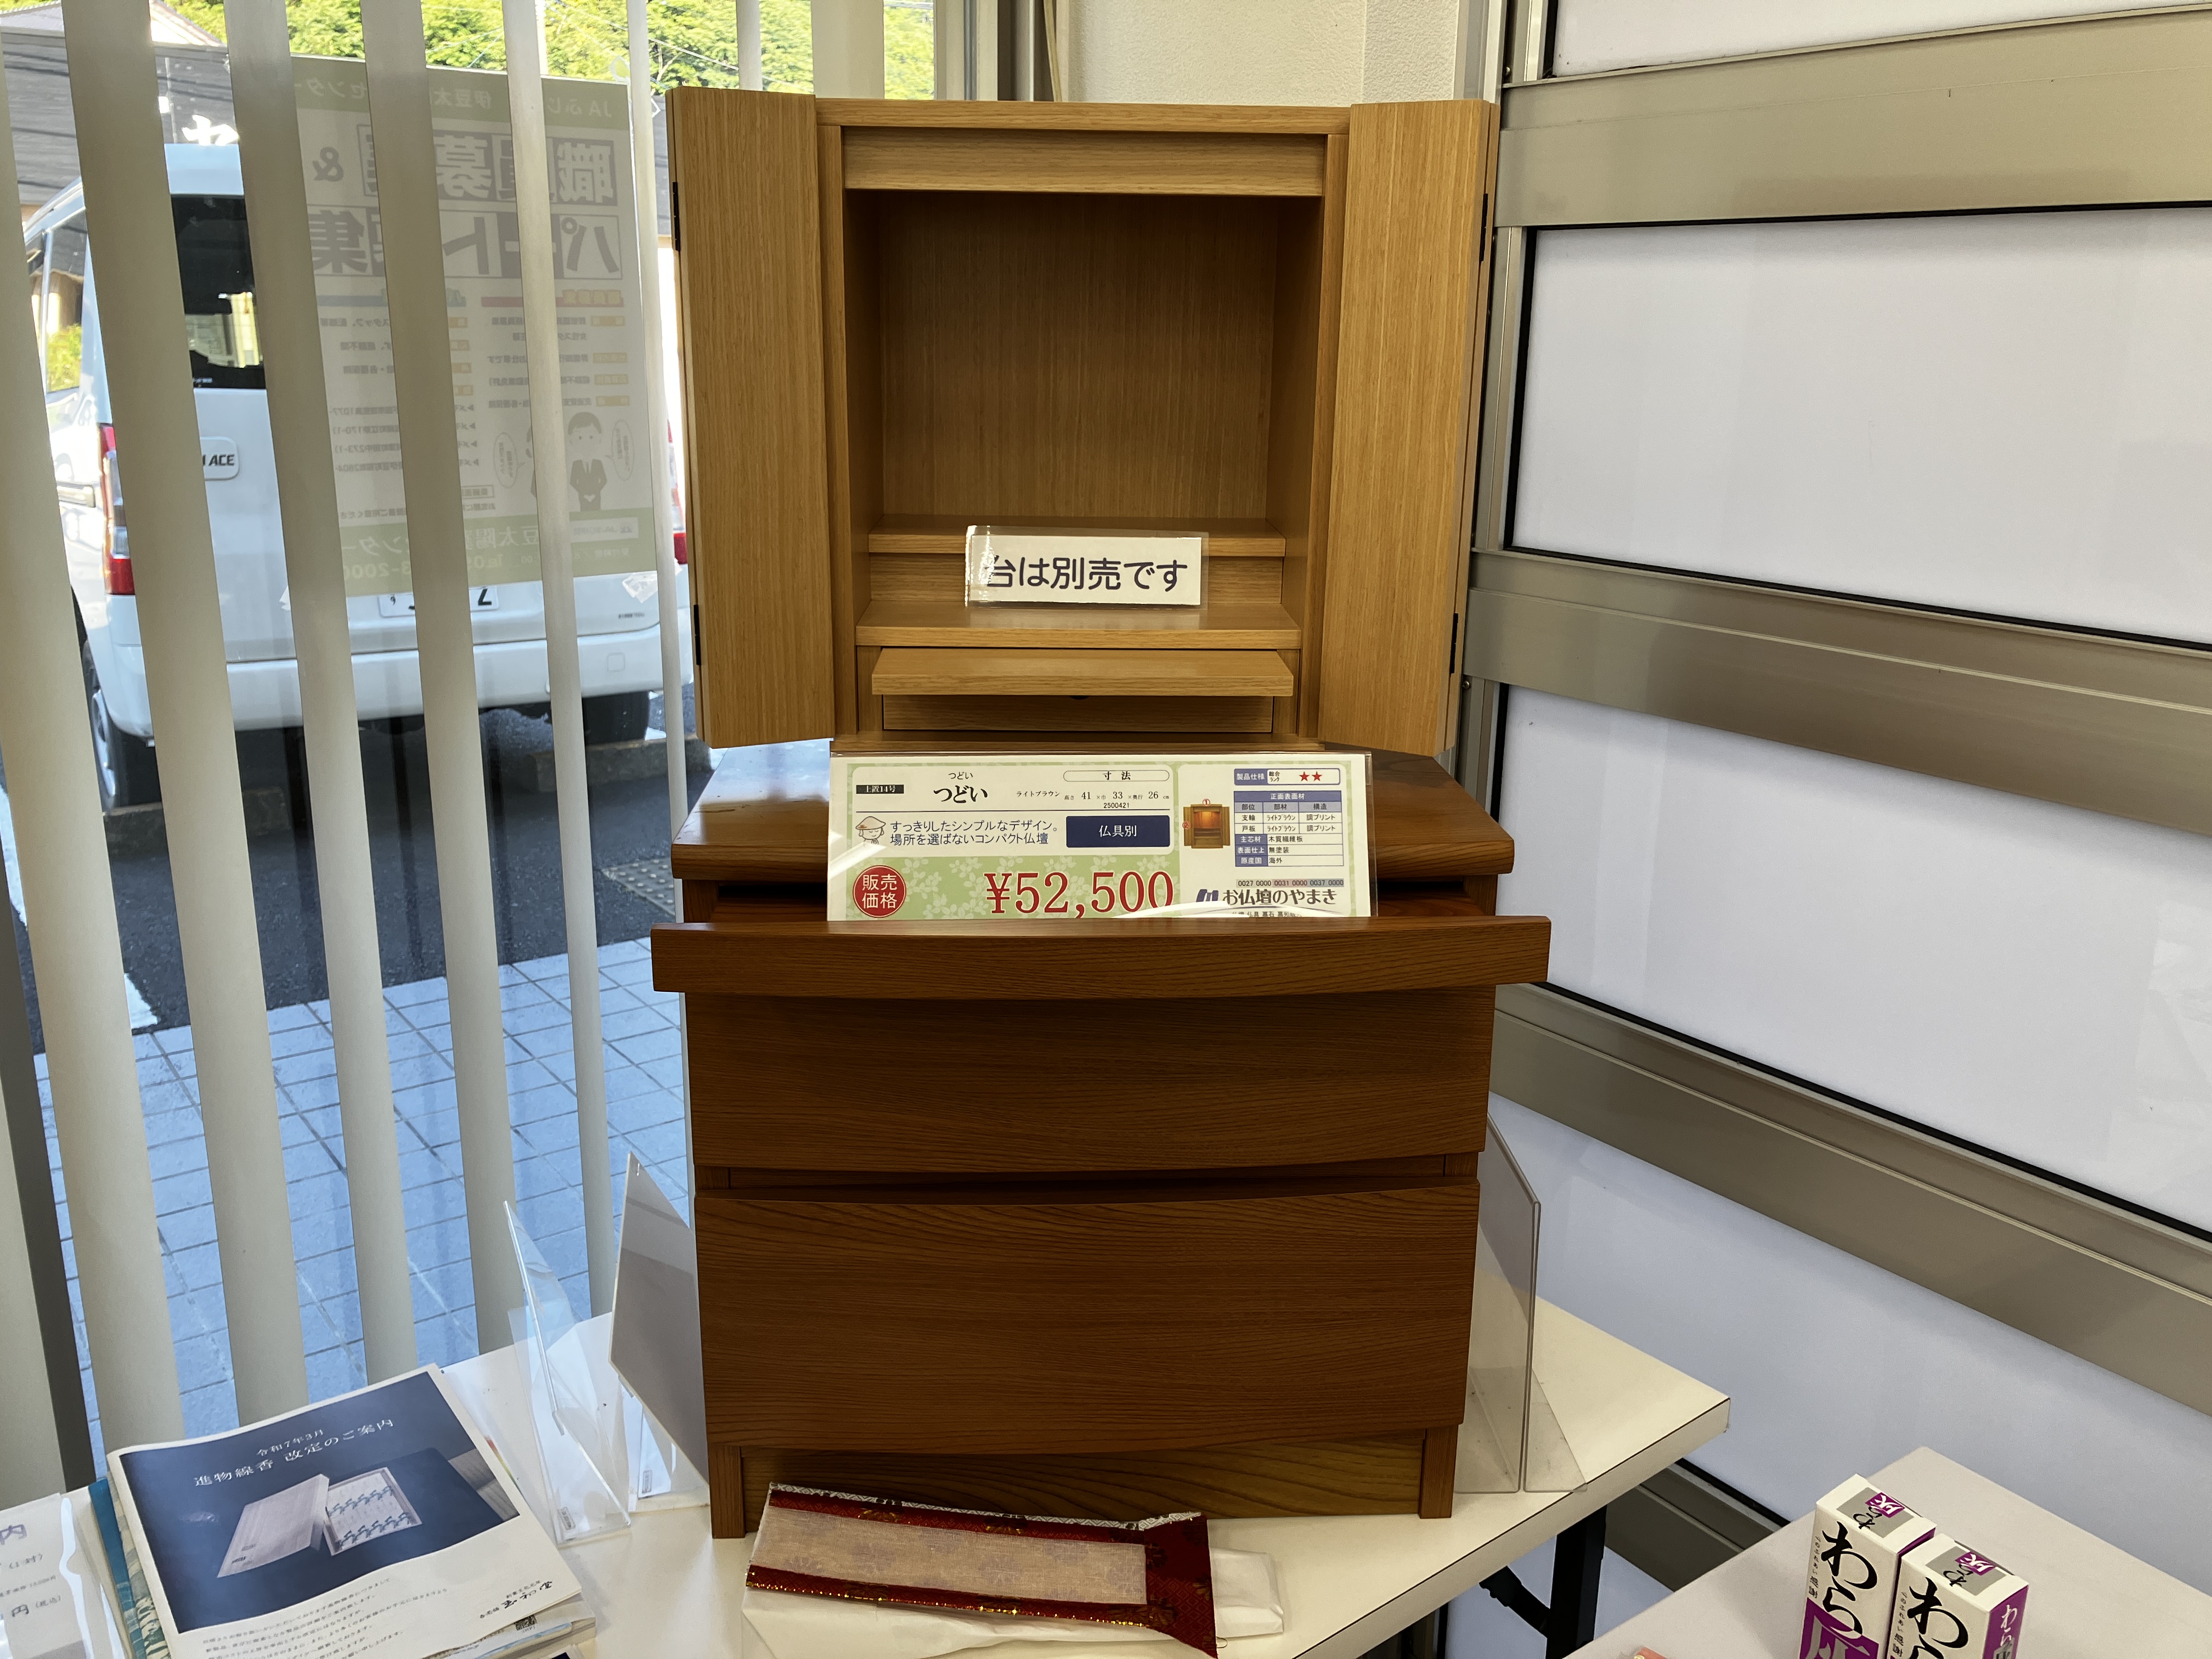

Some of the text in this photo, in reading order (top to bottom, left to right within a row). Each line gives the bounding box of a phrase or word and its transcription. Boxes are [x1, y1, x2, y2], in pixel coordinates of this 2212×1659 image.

[208, 454, 235, 467] ACE
[985, 555, 1188, 592] 台は別売です
[948, 771, 973, 780] つどい
[1236, 772, 1265, 781] 製品仕様
[933, 785, 988, 804] つどい
[1081, 791, 1091, 800] 41
[1112, 791, 1124, 800] 33
[1148, 791, 1159, 800] 26
[890, 819, 1057, 833] すっきりしたシンプルなデザイン。
[1098, 825, 1137, 838] 仏具別
[890, 832, 1048, 846] 場所を選ばないコンパクト仏壇
[861, 873, 898, 891] 販売
[861, 892, 898, 910] 価格
[984, 871, 1174, 918] ¥52,500
[1222, 888, 1337, 905] お仏壇のやまき
[256, 1429, 324, 1457] 令和7年3月
